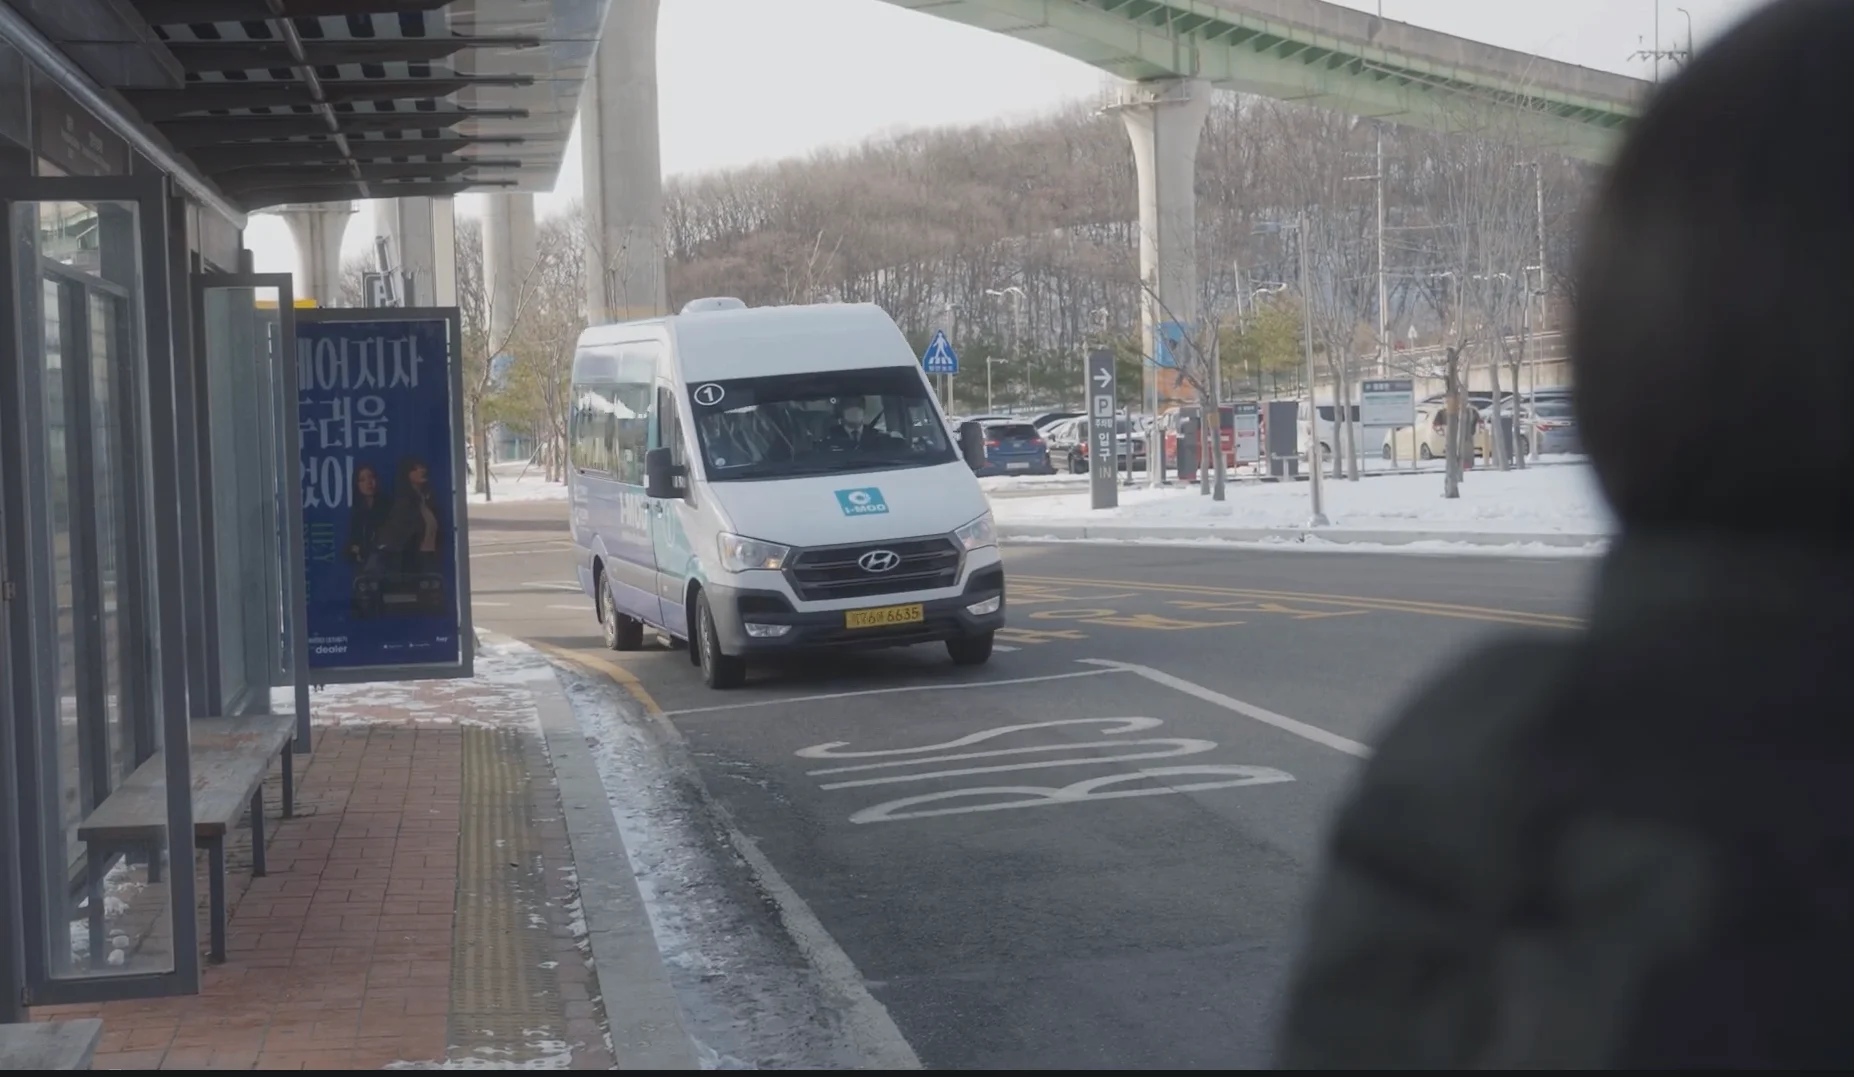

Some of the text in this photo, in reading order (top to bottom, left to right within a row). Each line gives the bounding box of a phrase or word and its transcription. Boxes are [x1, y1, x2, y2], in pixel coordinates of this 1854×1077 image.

[1099, 399, 1108, 414] P
[1098, 432, 1111, 462] 입구
[1099, 465, 1112, 479] IN
[315, 644, 348, 654] dealer
[795, 716, 1296, 825] BUS
